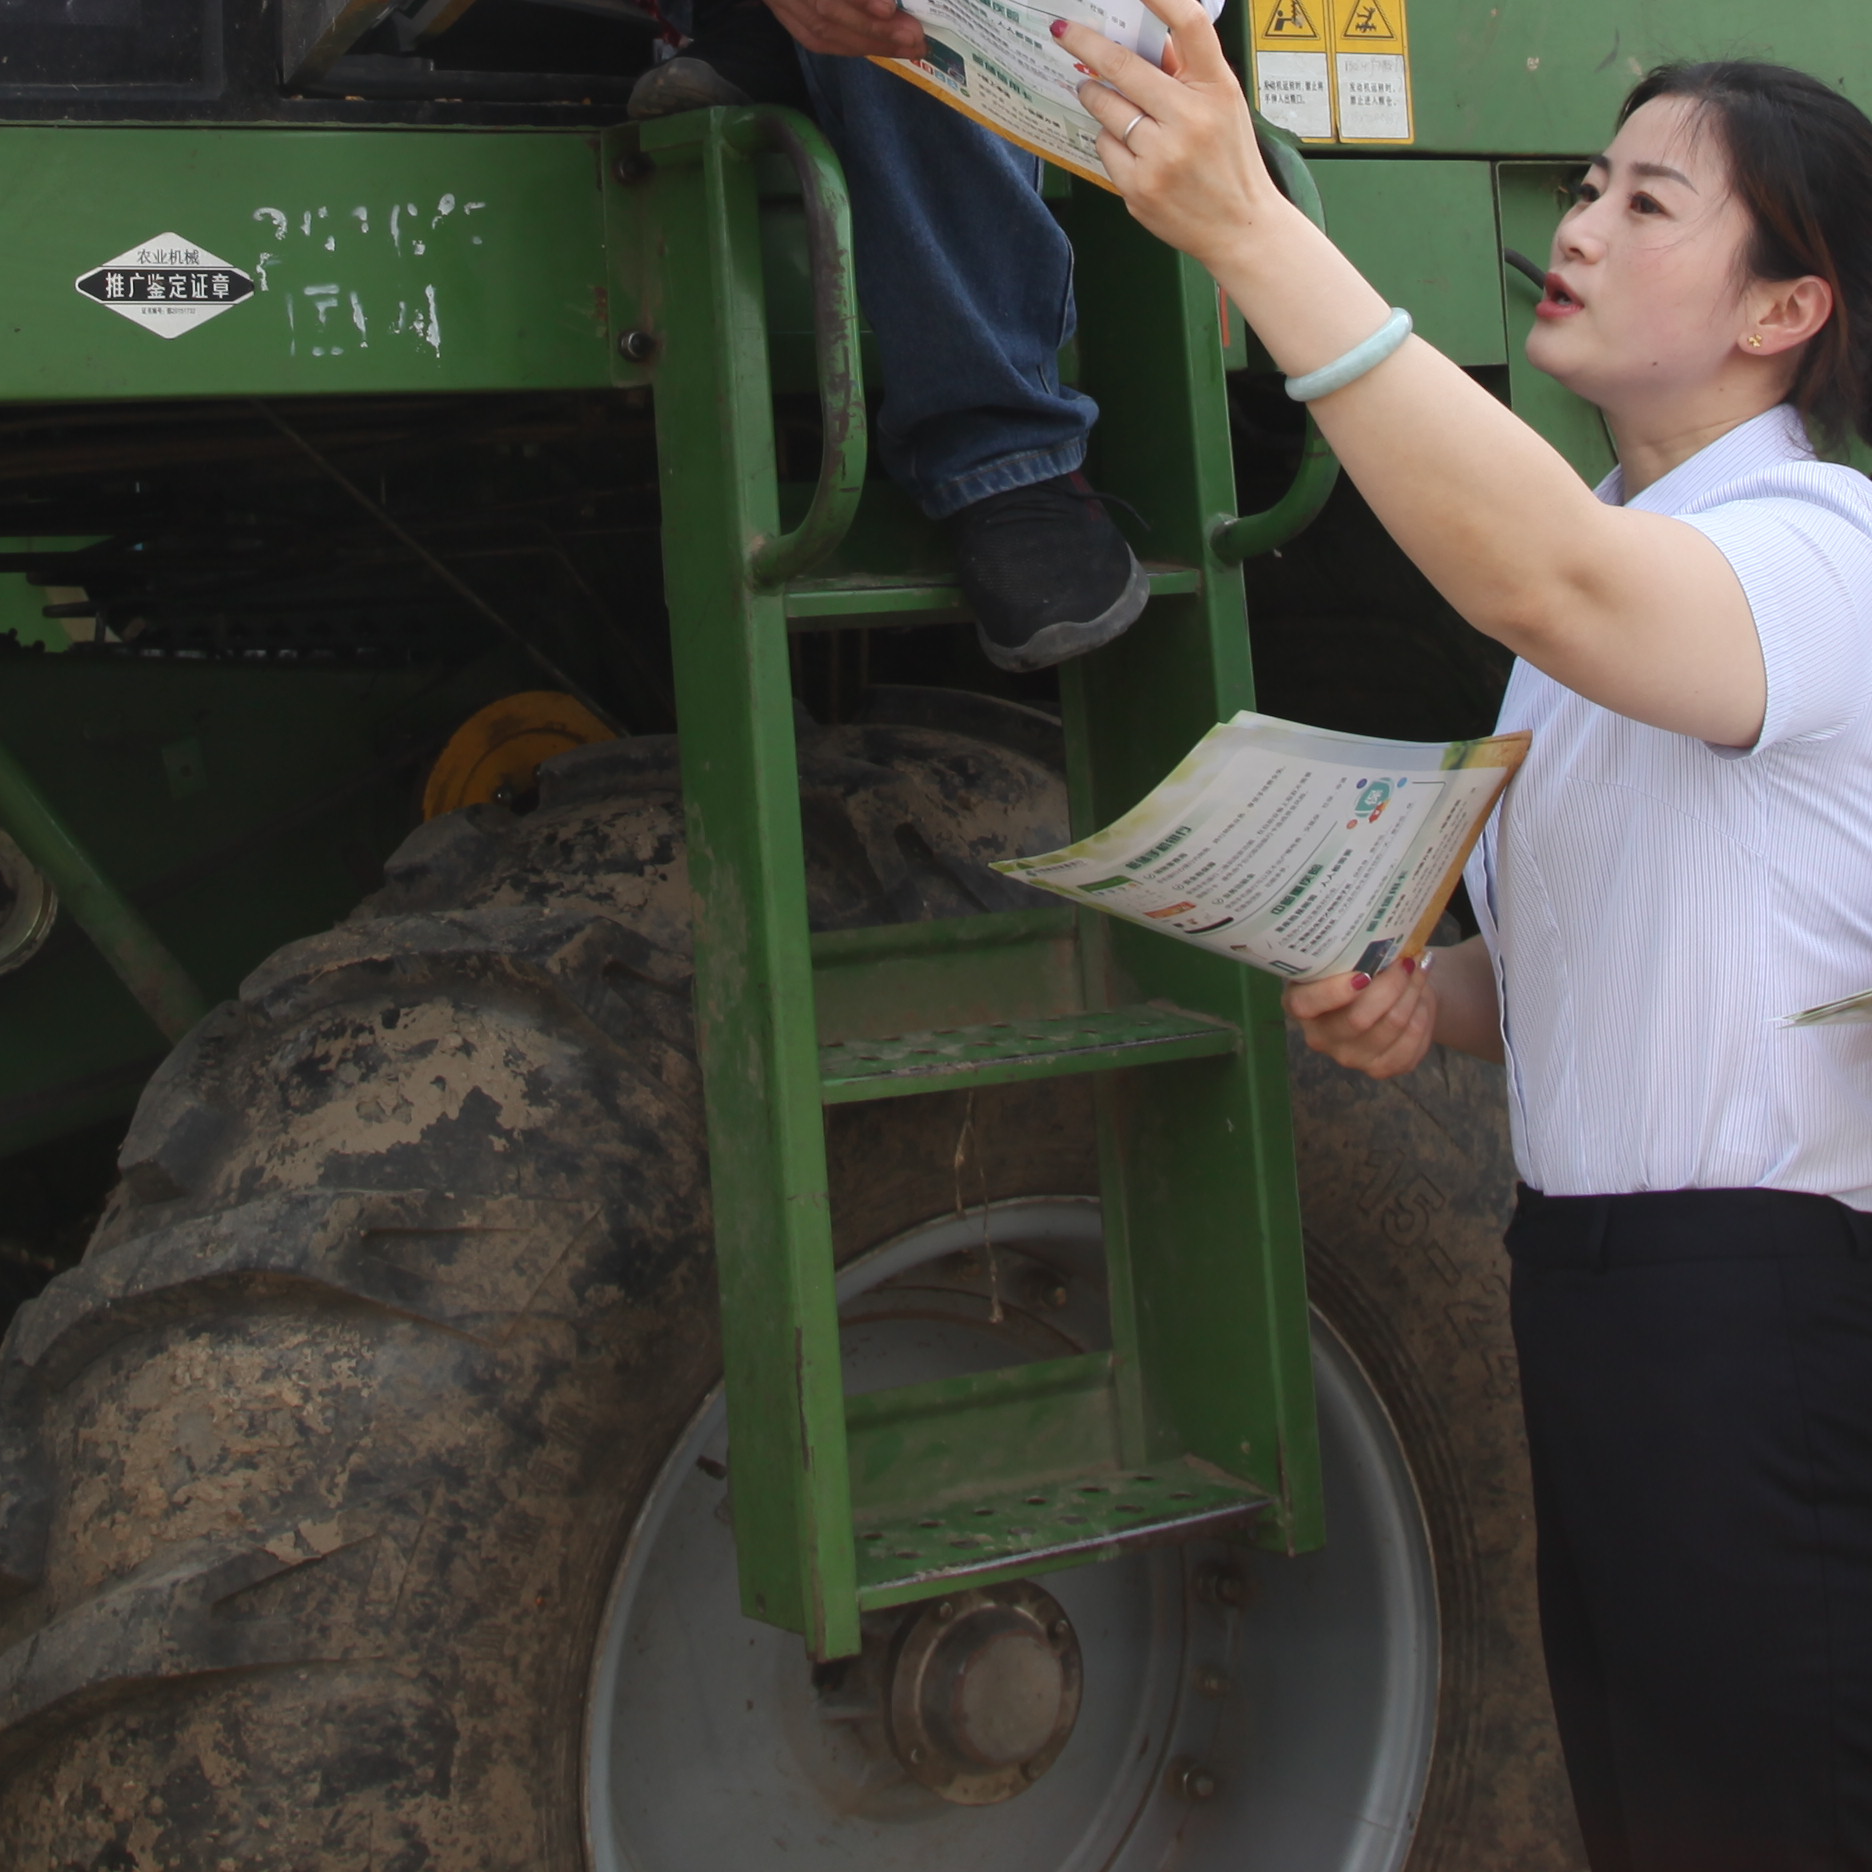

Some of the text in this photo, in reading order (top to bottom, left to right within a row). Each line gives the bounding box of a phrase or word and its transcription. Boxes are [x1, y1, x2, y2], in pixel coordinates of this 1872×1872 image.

[137, 249, 200, 265] 农业机械
[105, 271, 230, 299] 推广鉴定证章
